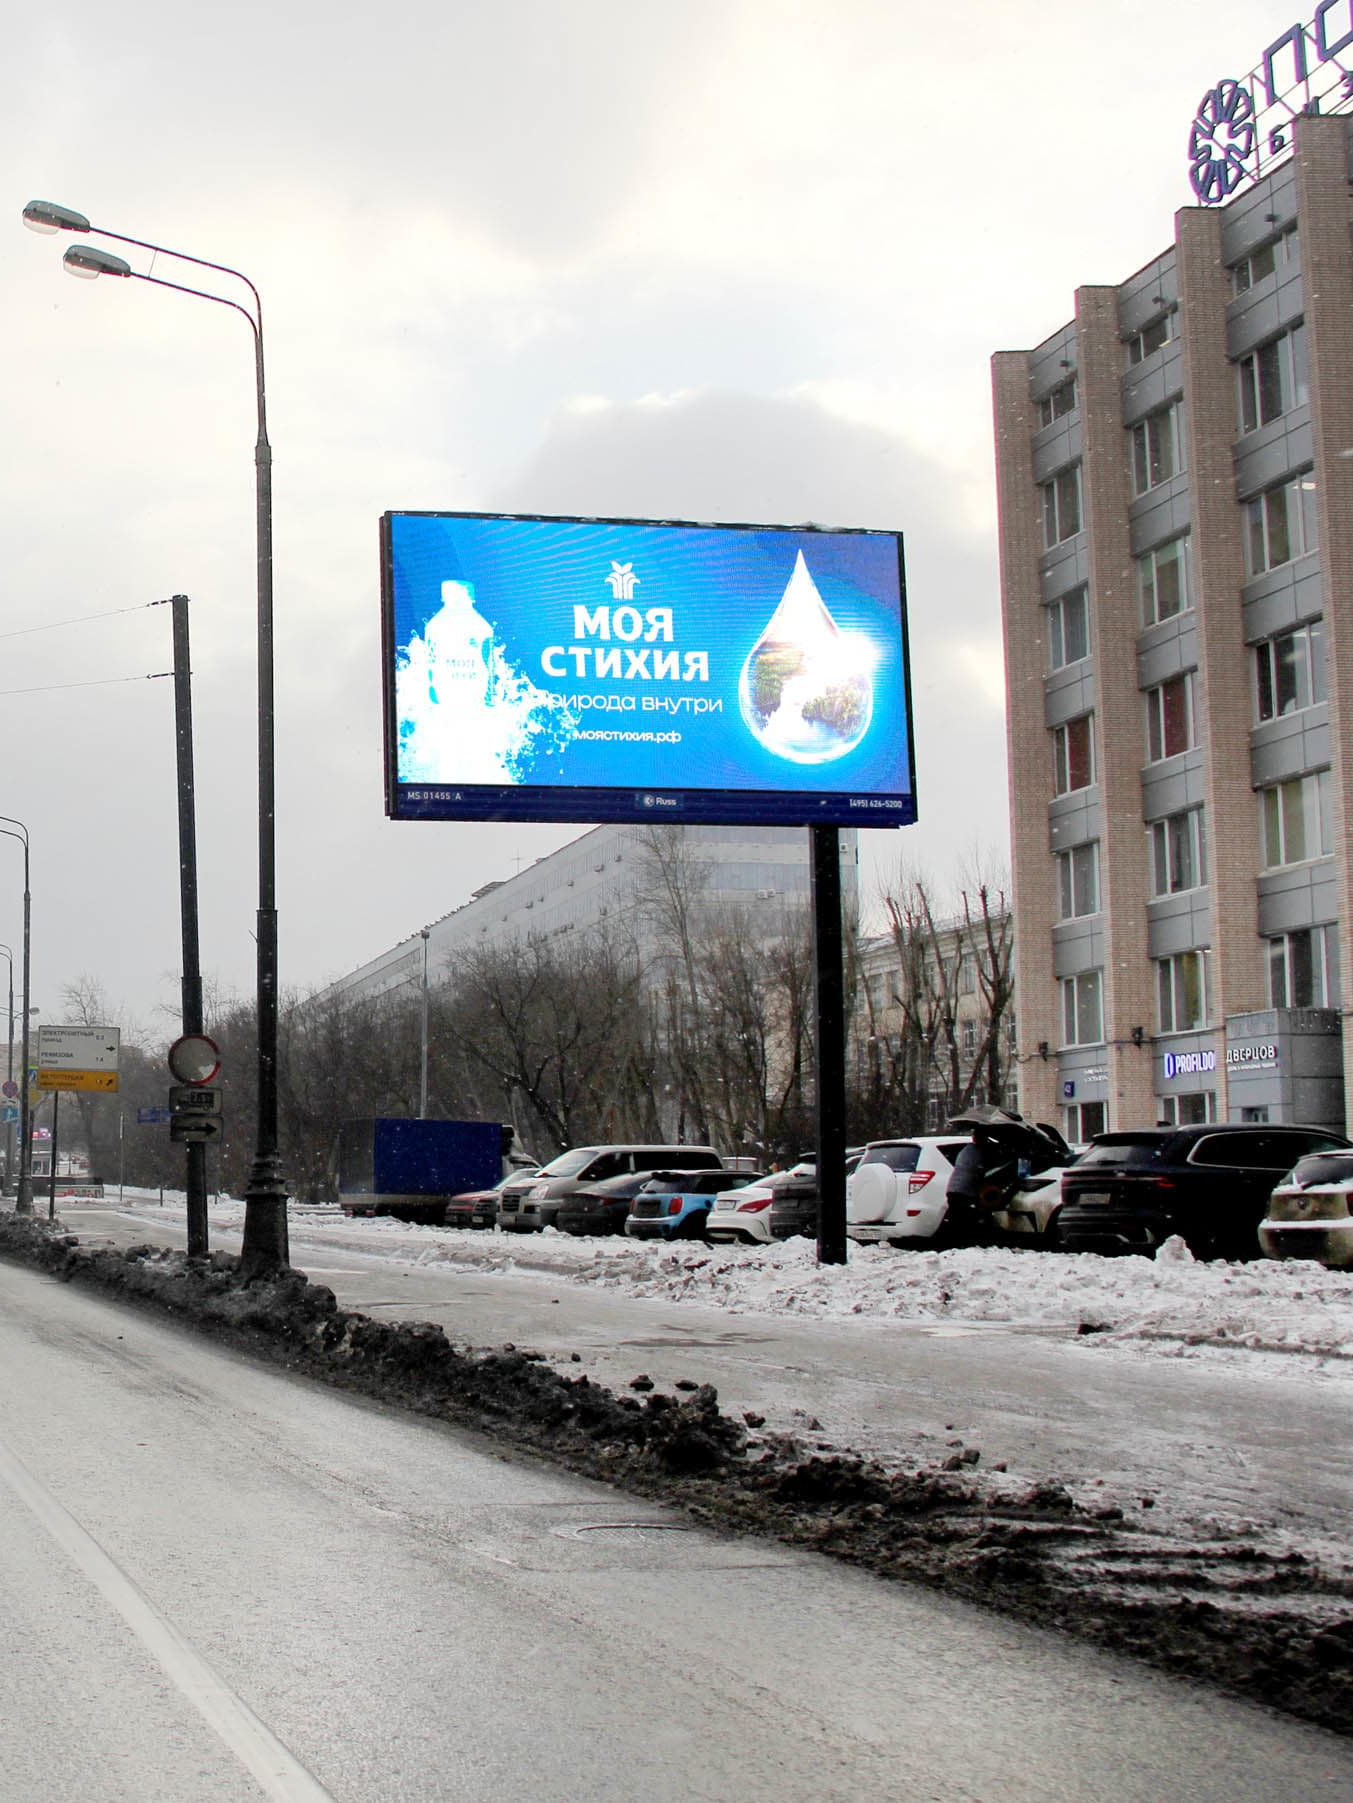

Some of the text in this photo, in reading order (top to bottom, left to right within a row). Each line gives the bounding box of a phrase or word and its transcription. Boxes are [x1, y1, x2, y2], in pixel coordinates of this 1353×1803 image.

[573, 604, 674, 642] МОЯ
[541, 646, 710, 682] СТИХИЯ
[535, 693, 724, 717] рирода внутри
[574, 729, 682, 745] моястихия.рф
[407, 791, 421, 800] MS
[655, 796, 677, 806] Russ
